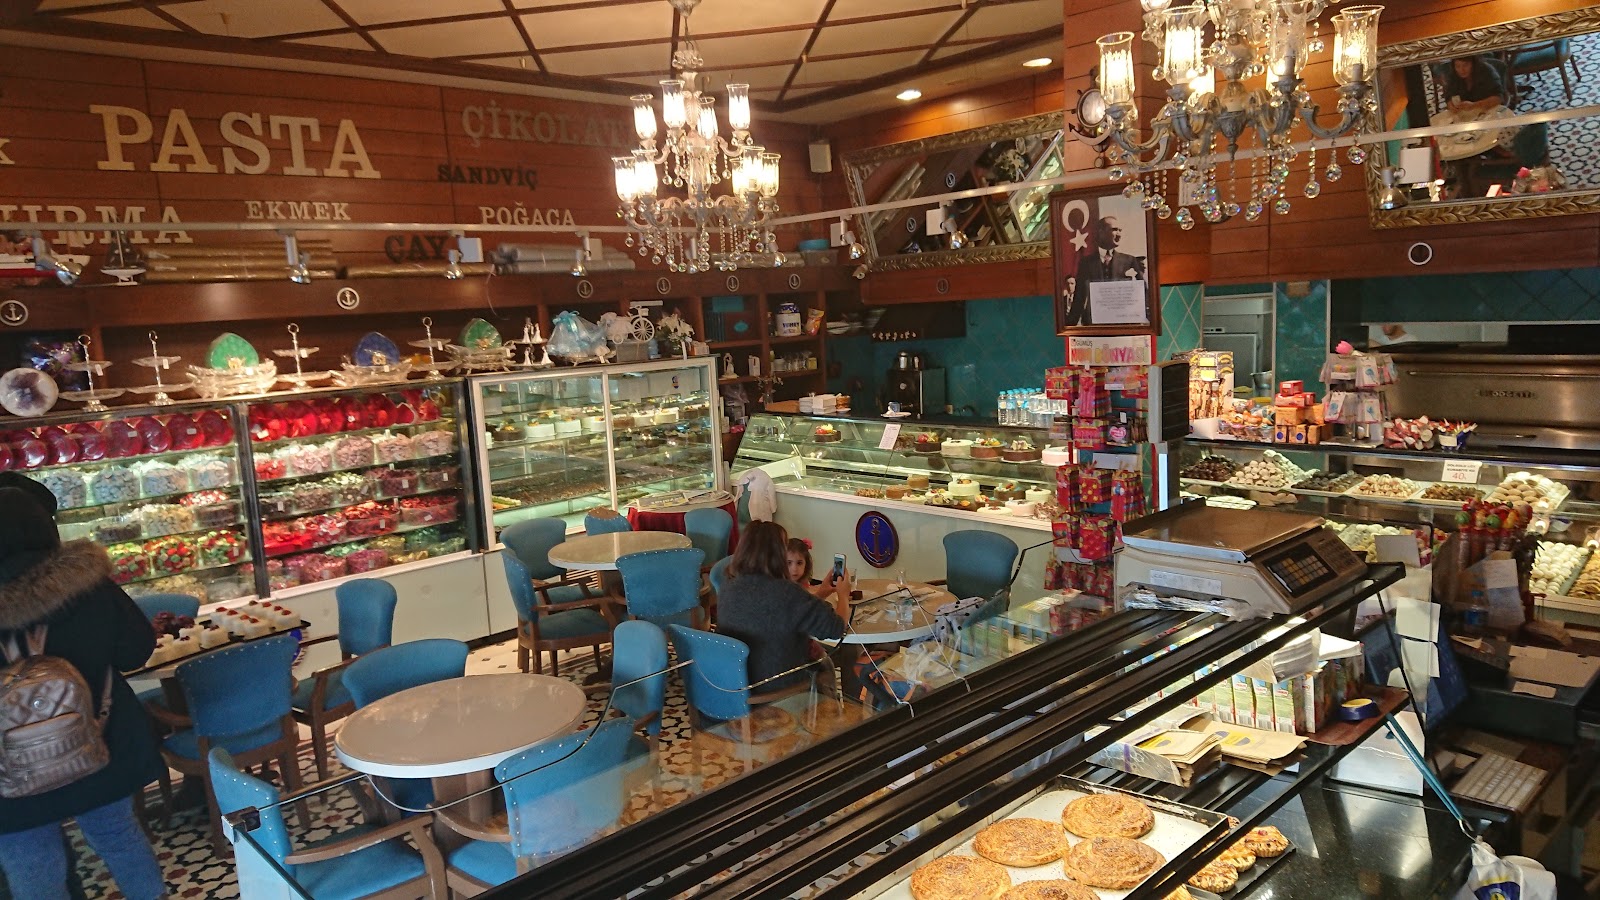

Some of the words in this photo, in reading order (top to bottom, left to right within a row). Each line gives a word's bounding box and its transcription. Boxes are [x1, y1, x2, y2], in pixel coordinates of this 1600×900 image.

[461, 100, 628, 149] ÇİKOLAT
[89, 104, 382, 179] PASTA
[437, 163, 539, 191] SANDVİÇ
[245, 200, 352, 221] EKMEK
[384, 234, 449, 264] ÇAY
